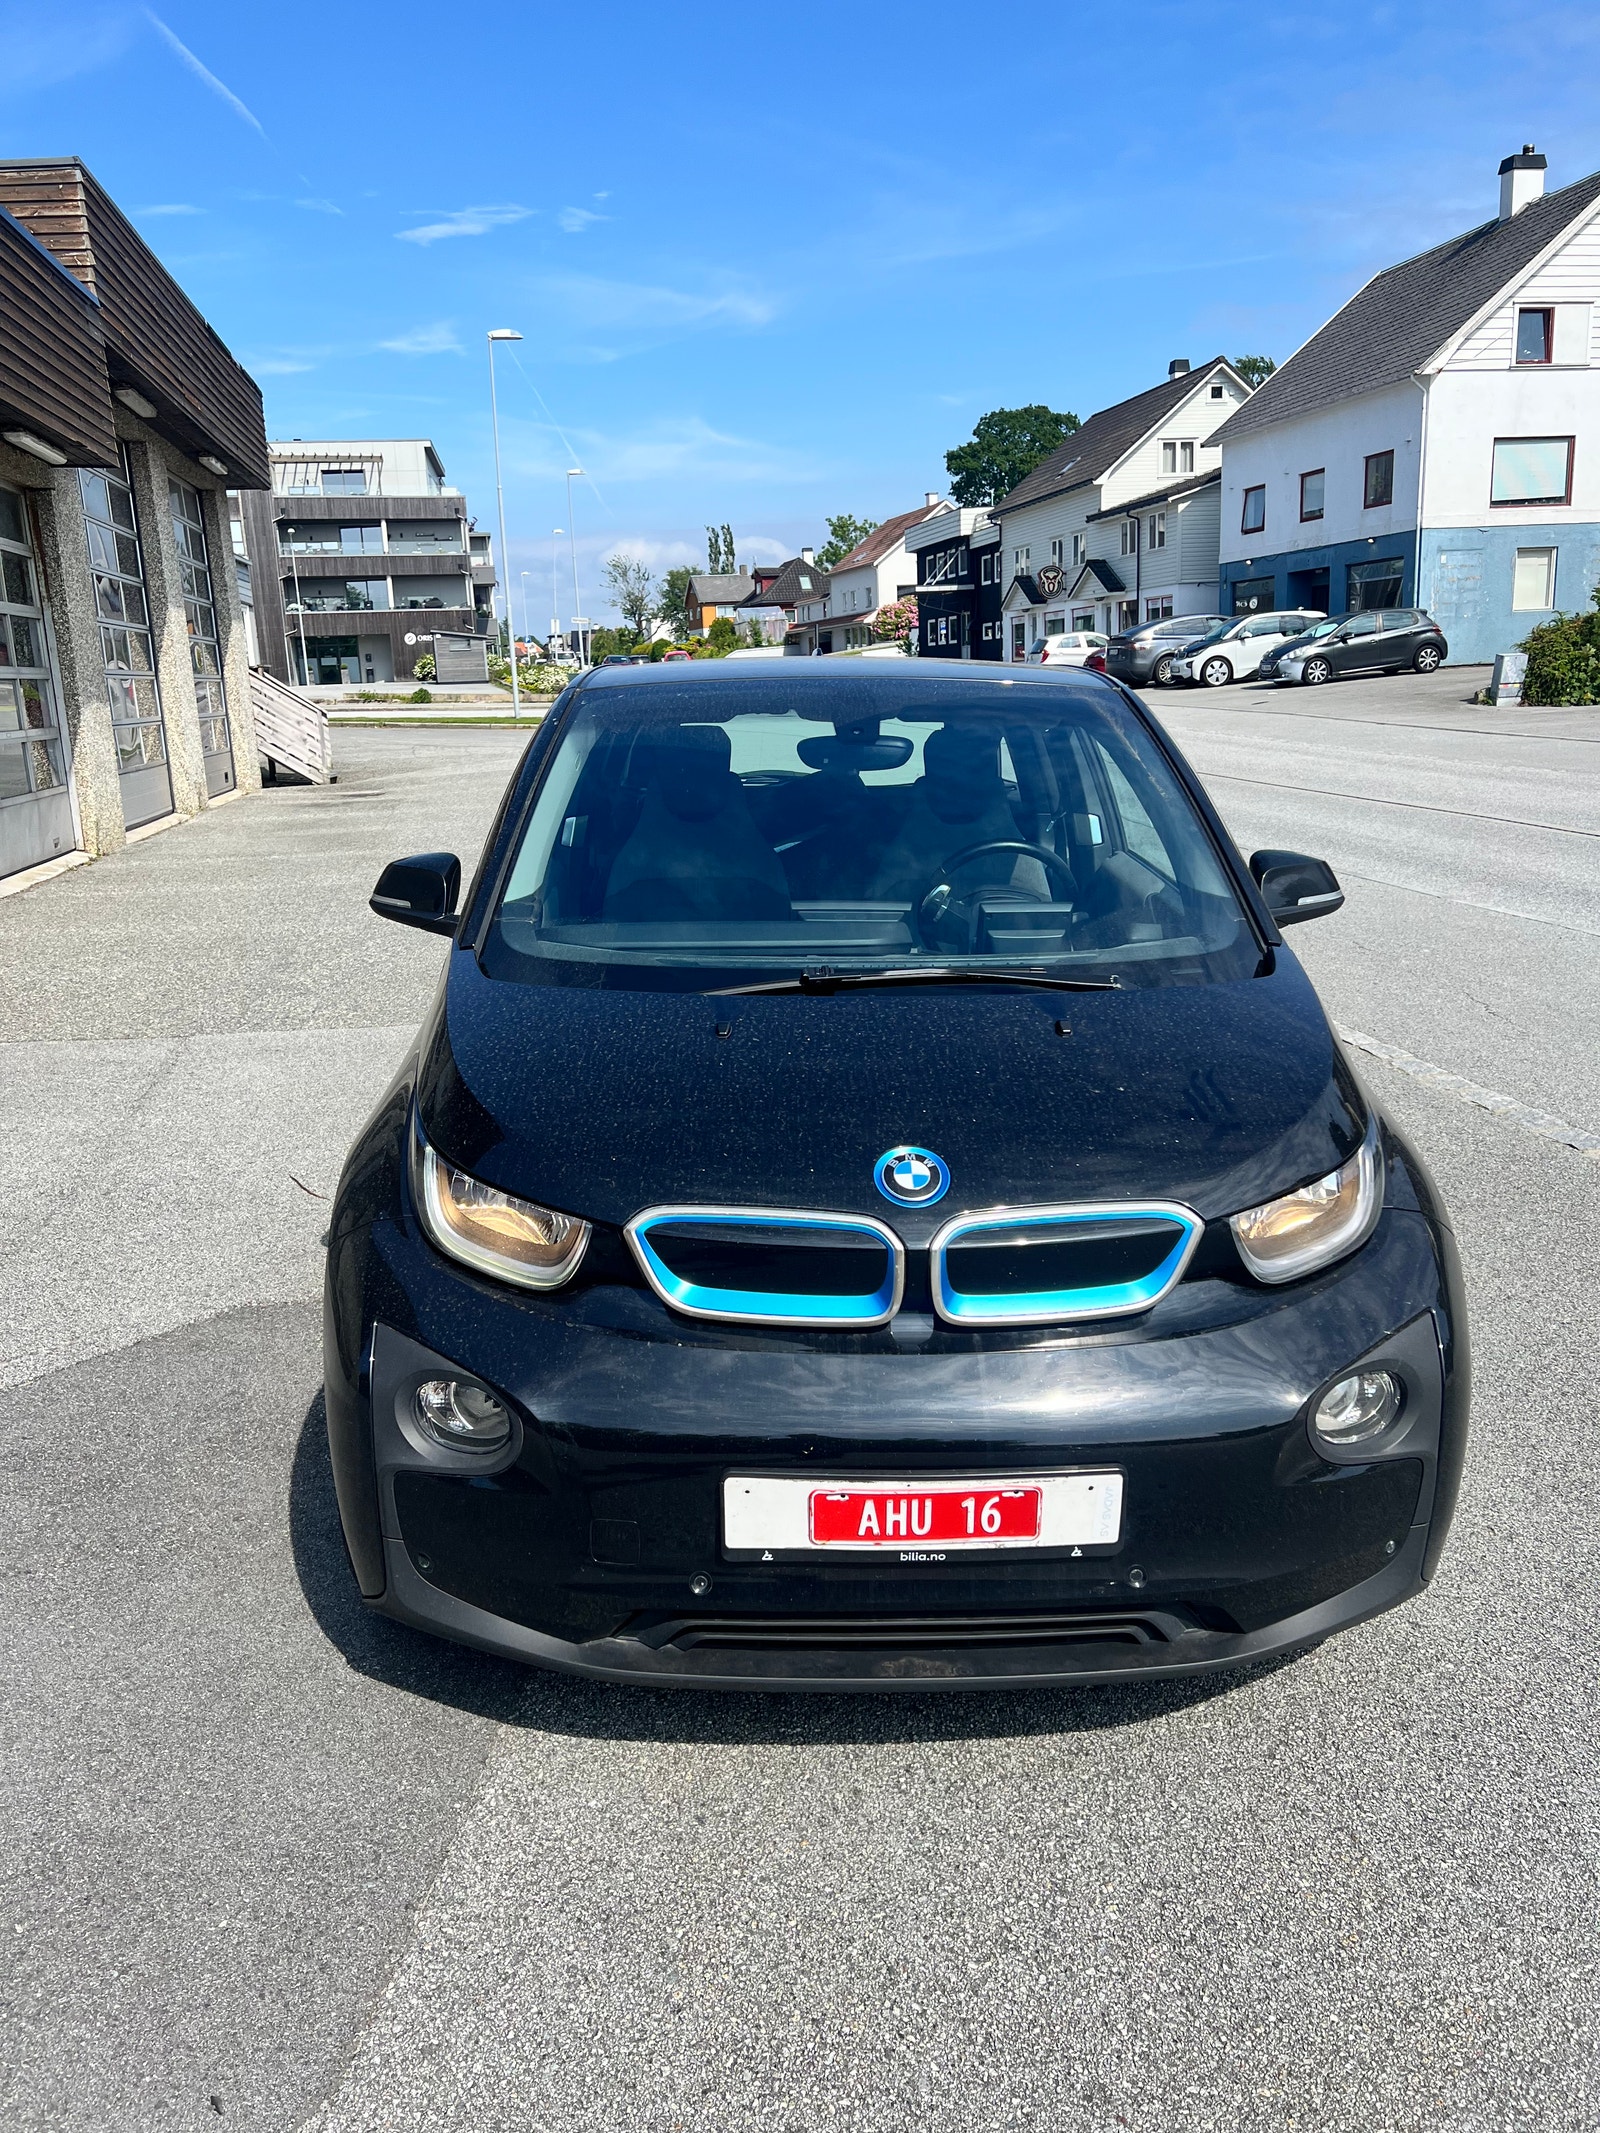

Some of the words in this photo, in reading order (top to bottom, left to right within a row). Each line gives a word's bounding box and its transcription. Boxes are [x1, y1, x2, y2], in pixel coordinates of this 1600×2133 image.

[887, 1153, 936, 1168] BMW
[858, 1498, 932, 1536] AHU
[961, 1496, 1002, 1534] 16
[900, 1551, 946, 1561] bilia.no
